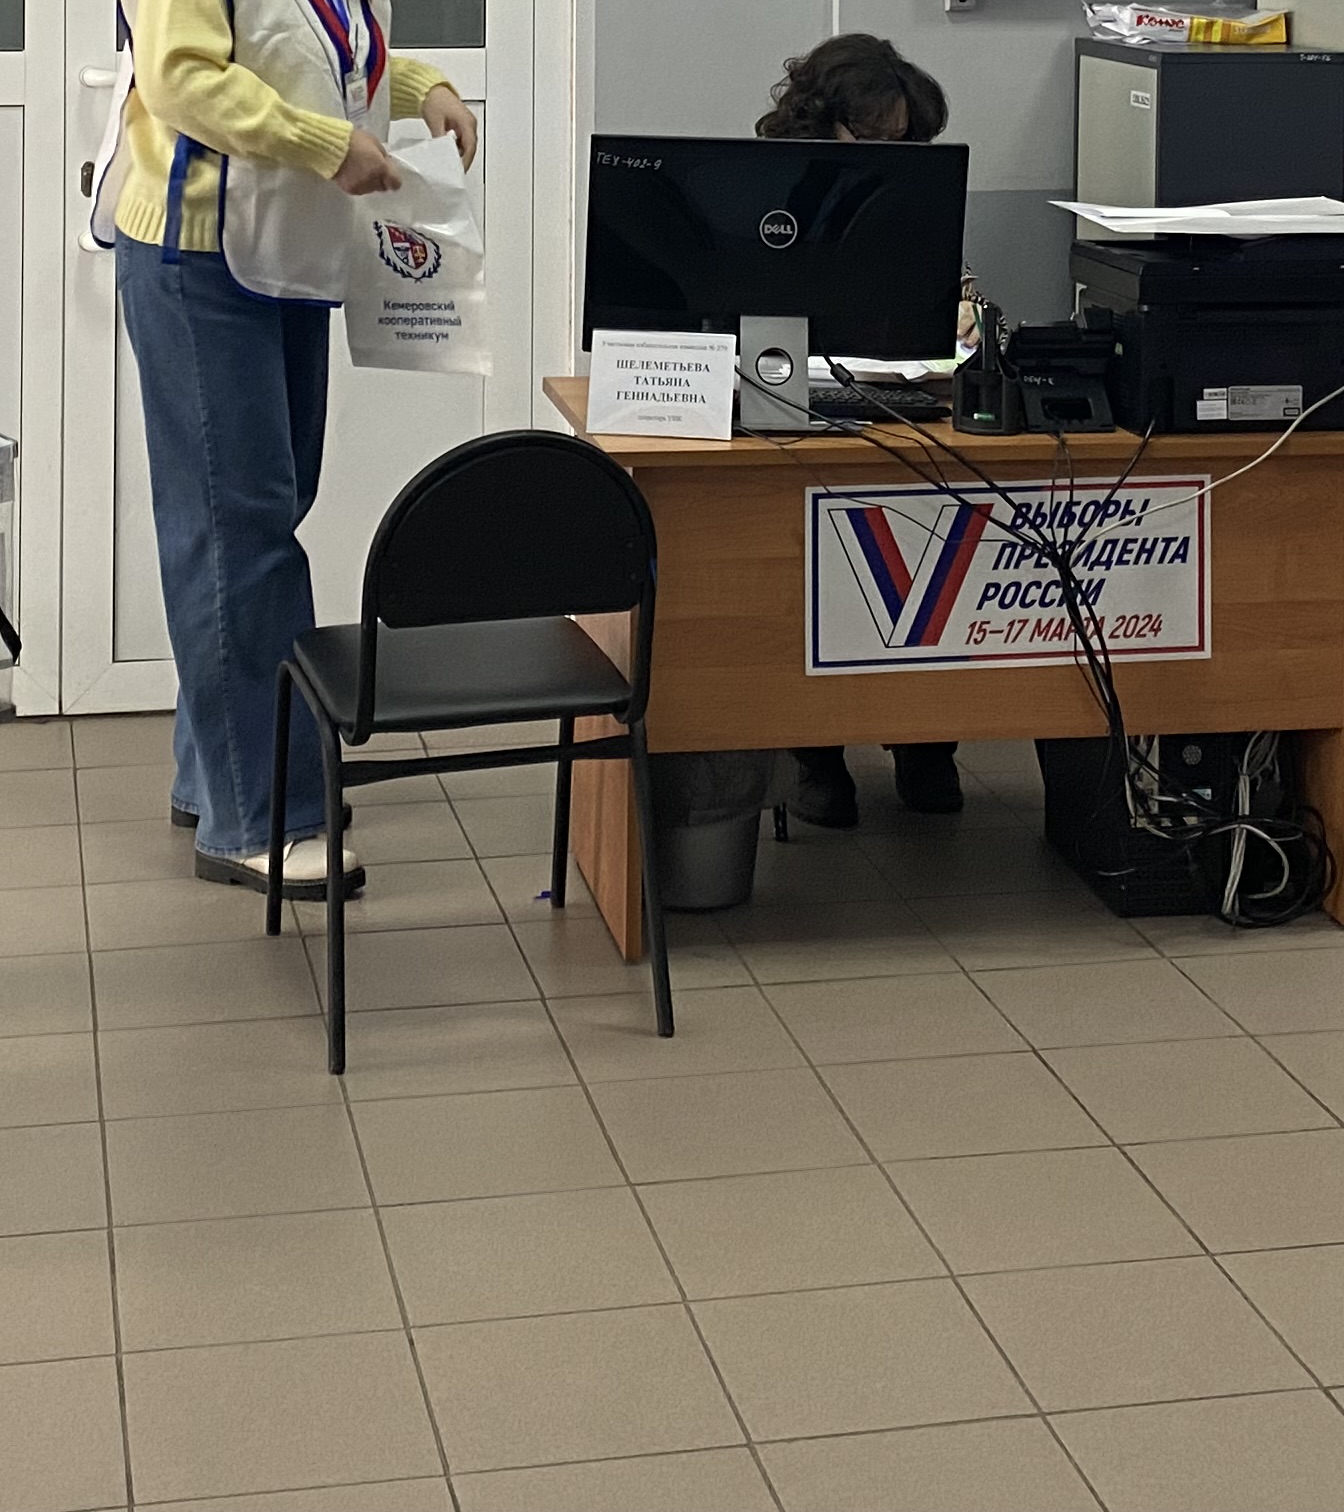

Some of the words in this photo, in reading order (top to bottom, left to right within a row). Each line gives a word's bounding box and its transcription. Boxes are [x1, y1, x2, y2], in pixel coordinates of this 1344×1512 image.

[764, 224, 793, 234] DELL
[383, 300, 455, 313] Кемеровский
[377, 316, 462, 328] кооперативный
[394, 331, 449, 343] техникум
[616, 359, 711, 373] ШЕЛЕМЕТЬЕВА
[634, 375, 691, 387] ТАТЬЯНА
[616, 390, 706, 404] ГЕННАДЬЕВНА
[1010, 498, 1151, 530] ВЫБОРЫ
[1108, 613, 1163, 639] 2024
